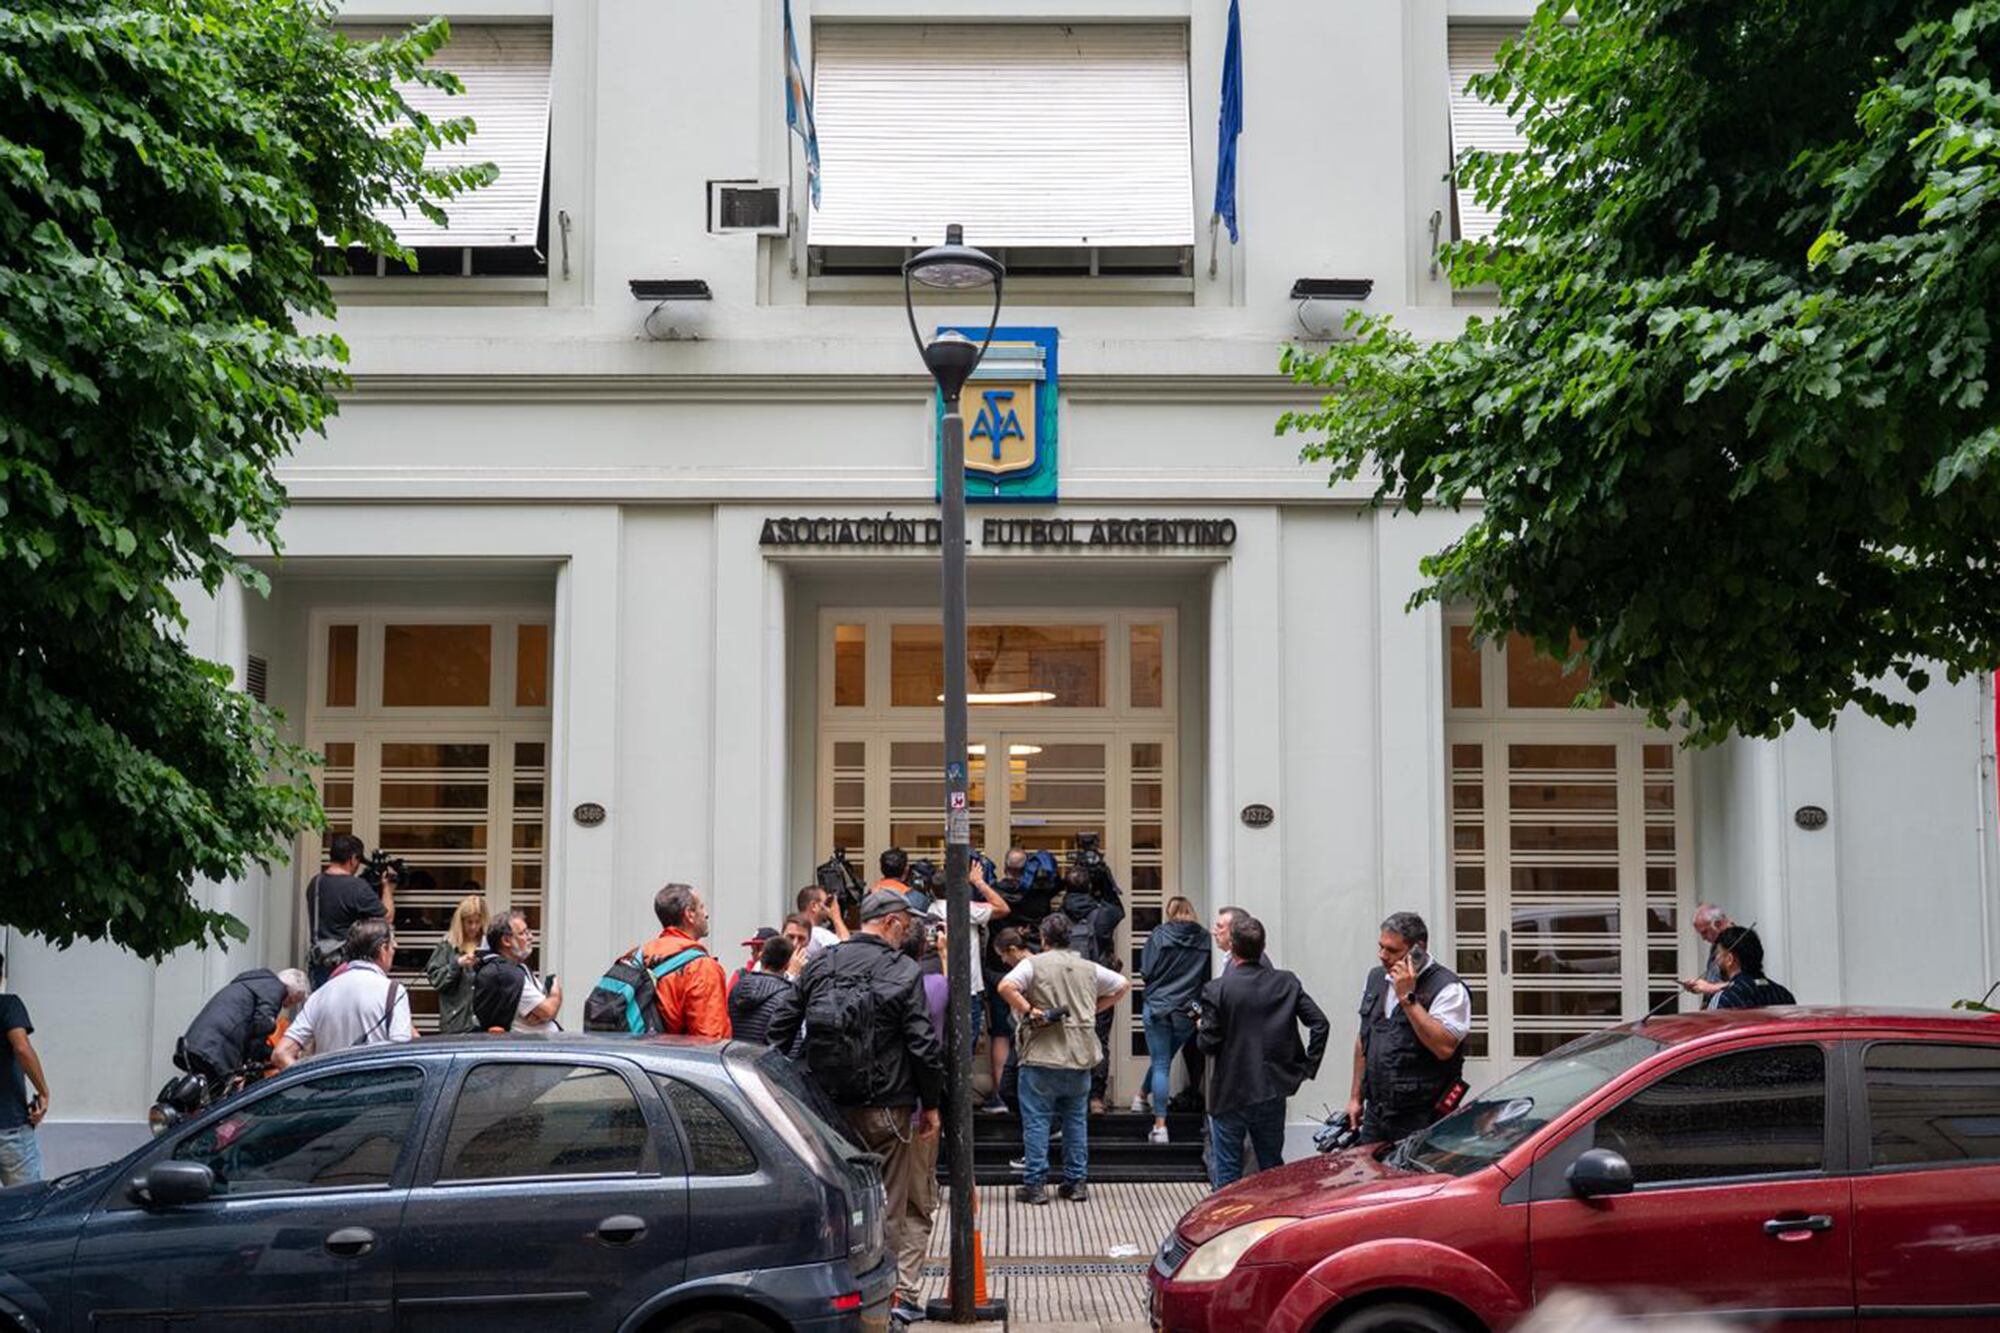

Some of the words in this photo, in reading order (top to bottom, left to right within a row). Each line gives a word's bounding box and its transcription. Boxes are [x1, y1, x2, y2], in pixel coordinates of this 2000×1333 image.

[759, 511, 916, 545] ASOCIACIÓN
[982, 518, 1083, 546] FUTBOL
[1089, 518, 1237, 547] ARGENTINO
